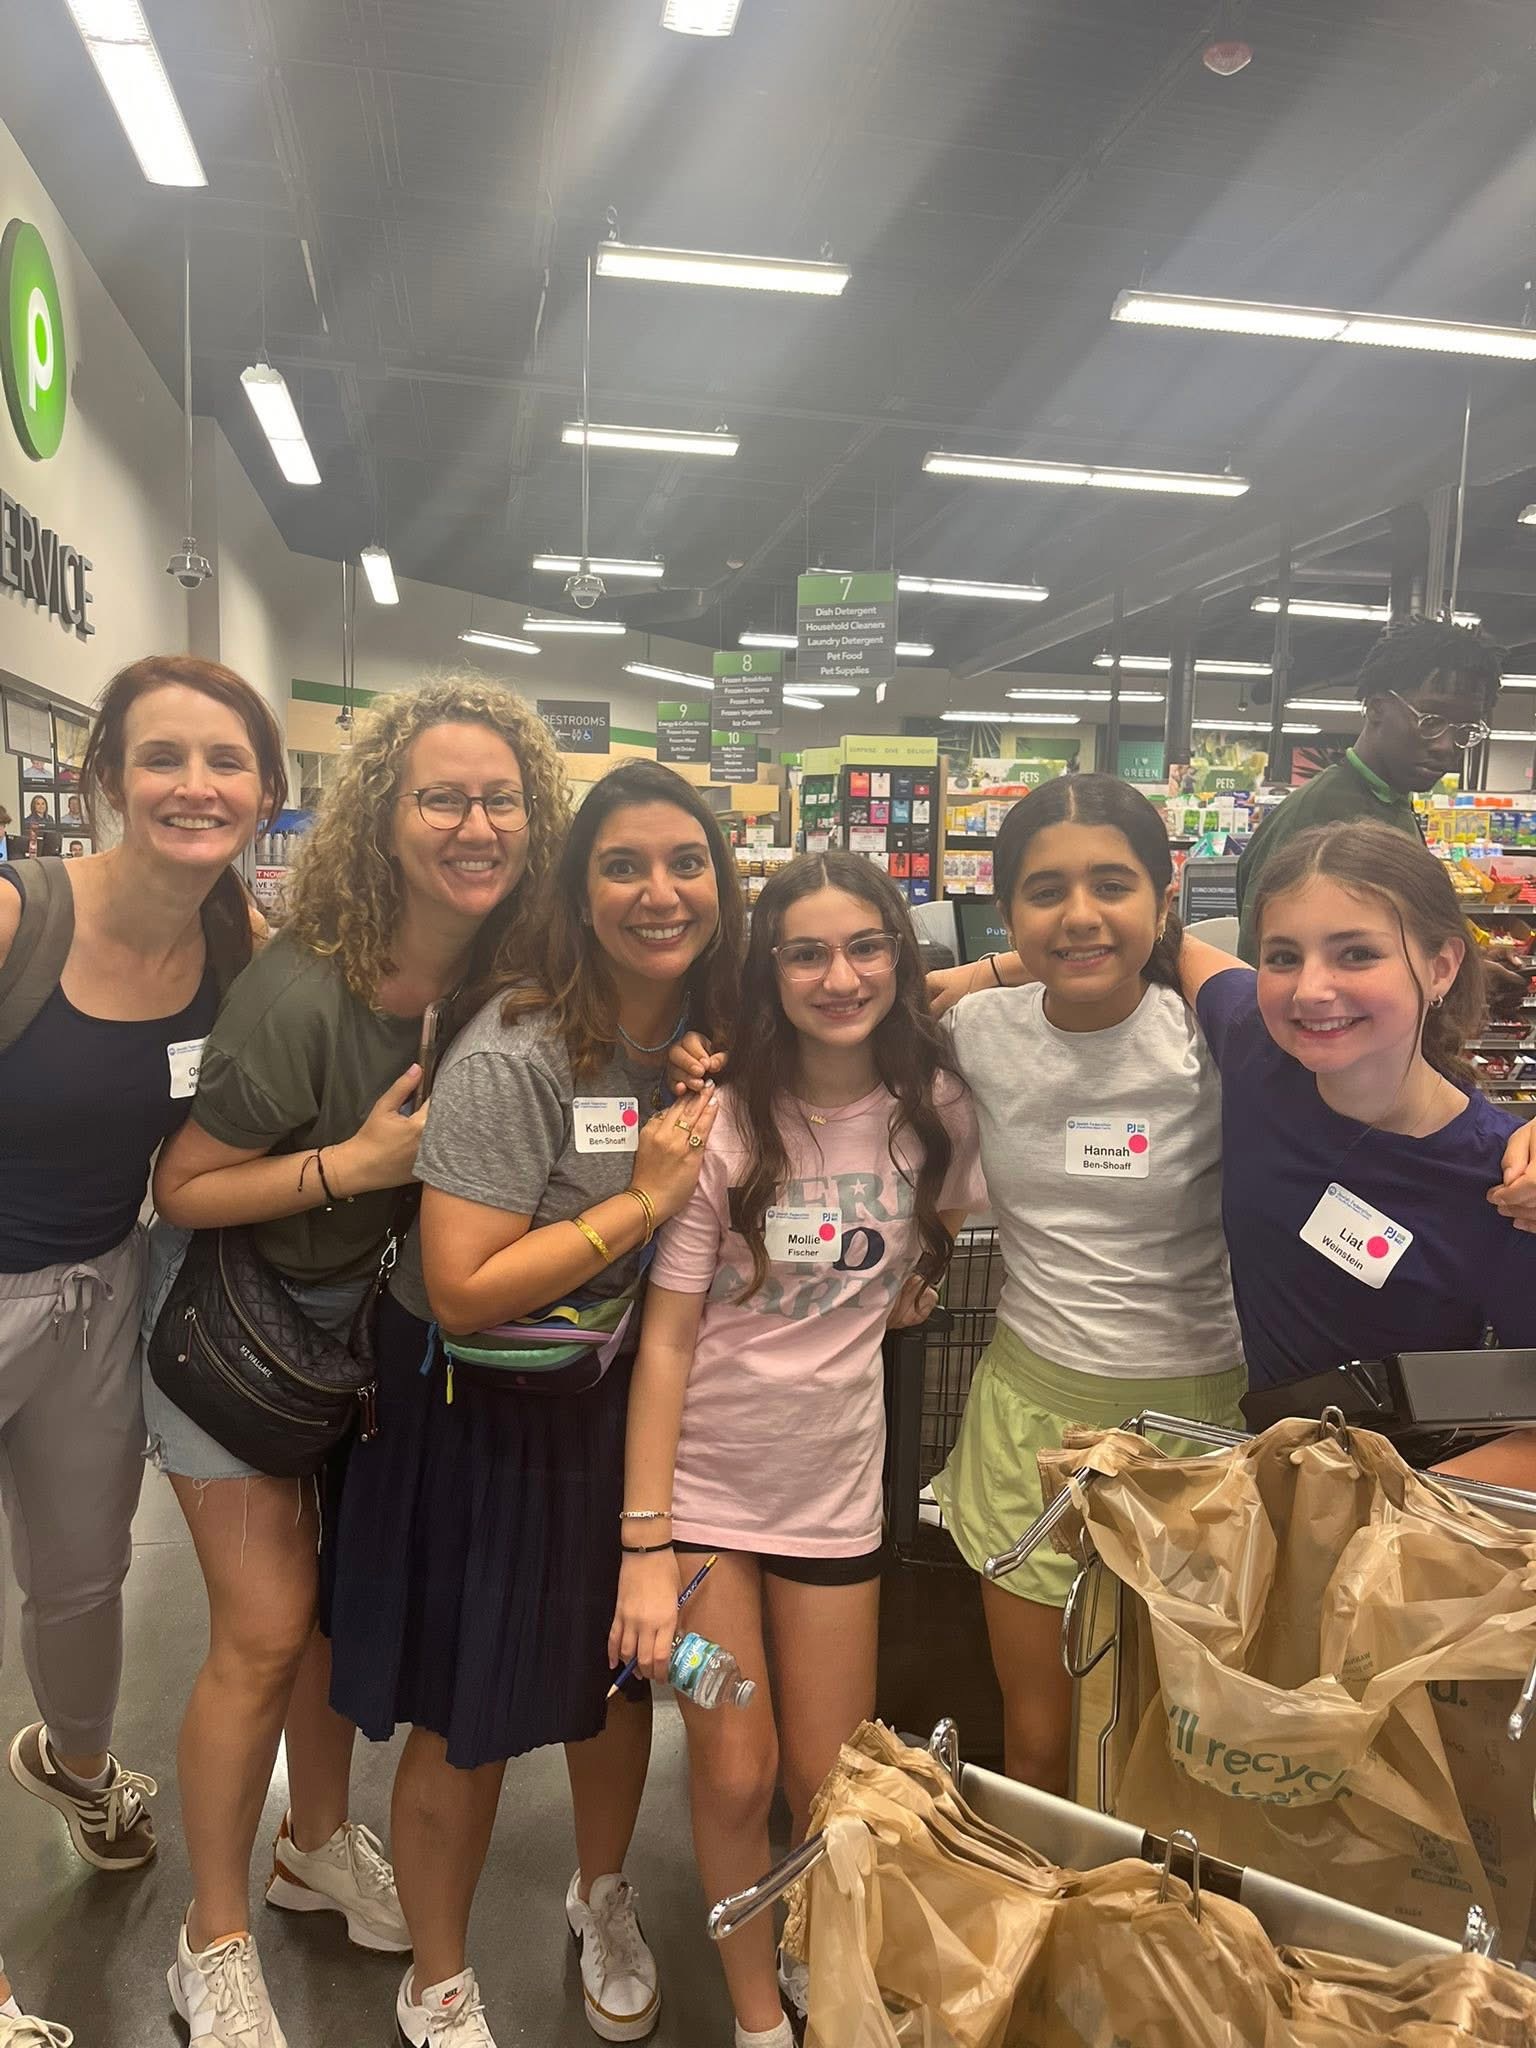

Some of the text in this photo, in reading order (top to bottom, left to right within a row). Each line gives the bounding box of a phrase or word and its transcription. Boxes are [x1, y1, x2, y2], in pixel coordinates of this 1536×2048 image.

[840, 576, 853, 600] 7
[815, 606, 877, 617] Dish Detergent
[806, 621, 885, 631] Household Cleaners
[807, 636, 883, 648] Laundry Detergent
[827, 651, 863, 660] Pet Food
[742, 654, 752, 671] 8
[820, 666, 870, 676] Pet Supplies
[679, 704, 687, 718] 9
[741, 709, 773, 717] Vegetables
[542, 714, 606, 727] RESTROOMS
[728, 732, 739, 744] 10
[1020, 772, 1039, 783] PETS
[1124, 768, 1160, 778] GREEN
[1216, 778, 1235, 789] PETS
[619, 1102, 627, 1110] PJ
[585, 1124, 627, 1133] Kathleen
[1127, 1123, 1136, 1133] PJ
[1084, 1145, 1130, 1157] Hannah
[1083, 1160, 1132, 1170] Ben-Shoaff
[822, 1213, 831, 1221] PJ
[1384, 1226, 1397, 1240] PJ
[788, 1234, 820, 1245] Mollie
[1339, 1227, 1364, 1252] Liat
[788, 1248, 819, 1257] Fischer
[1321, 1235, 1364, 1271] Weinstein
[248, 1353, 273, 1378] WALLACE
